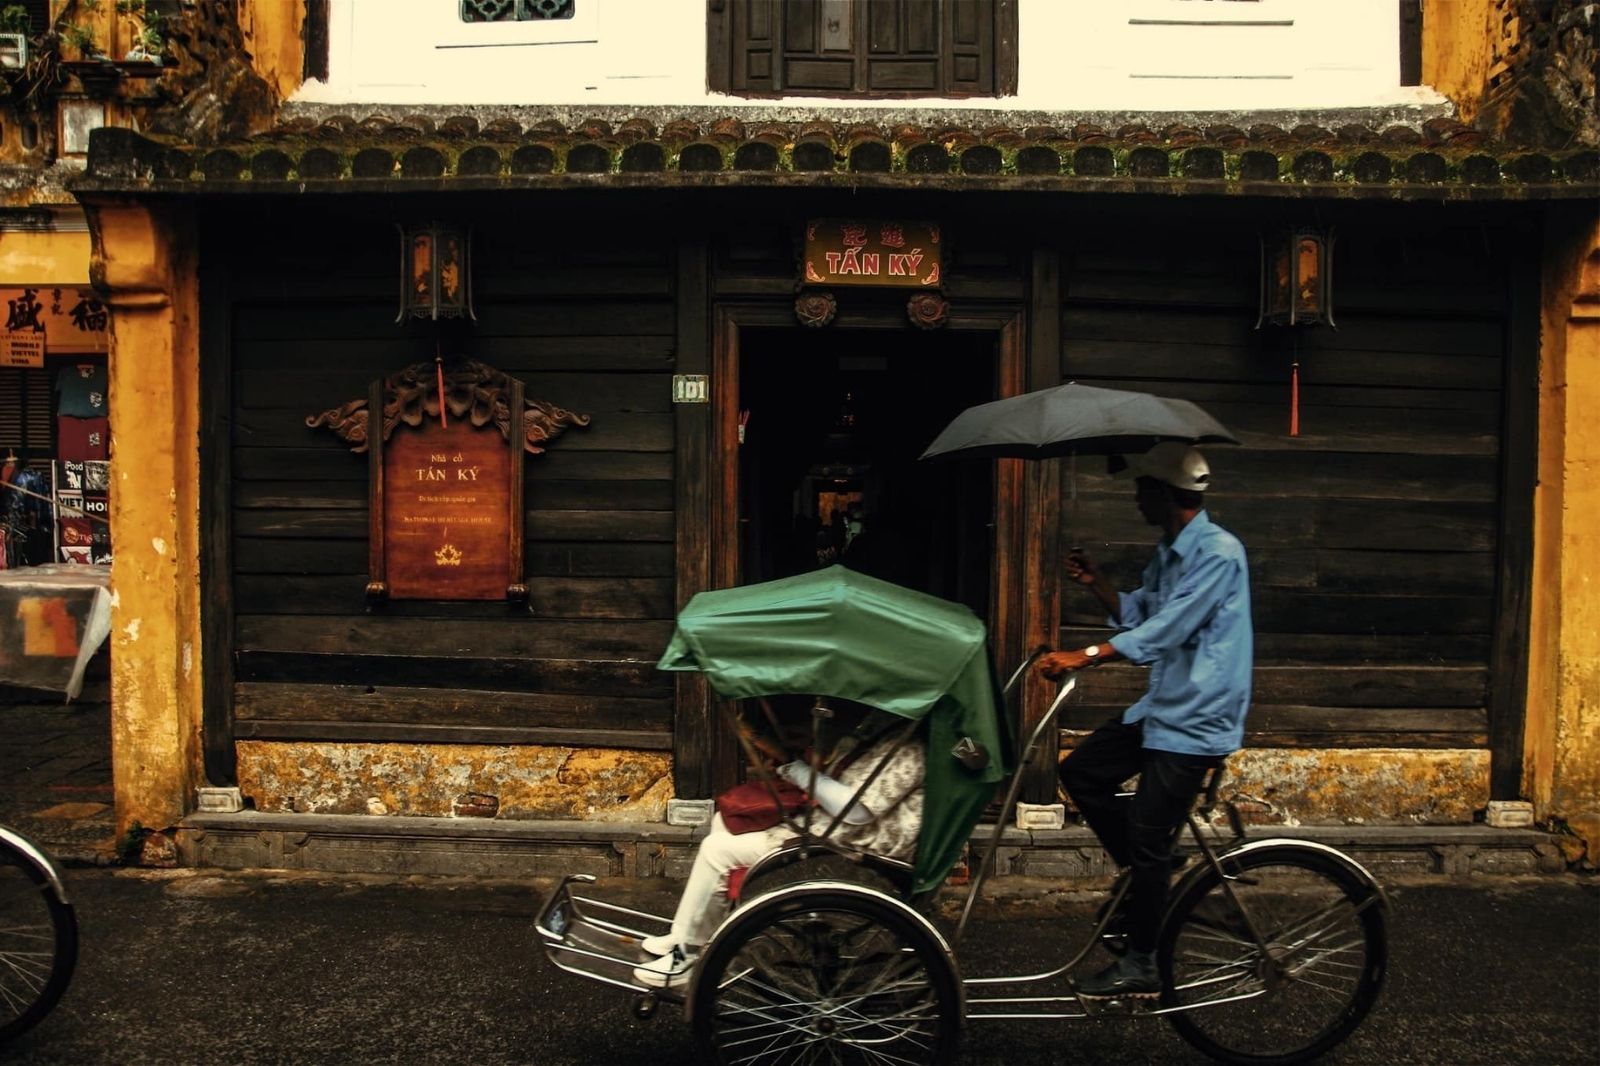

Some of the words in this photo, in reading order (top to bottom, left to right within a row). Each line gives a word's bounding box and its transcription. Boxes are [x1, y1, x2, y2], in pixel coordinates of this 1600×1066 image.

[825, 246, 880, 275] TẤN
[888, 248, 923, 276] KÝ
[677, 380, 705, 399] 101
